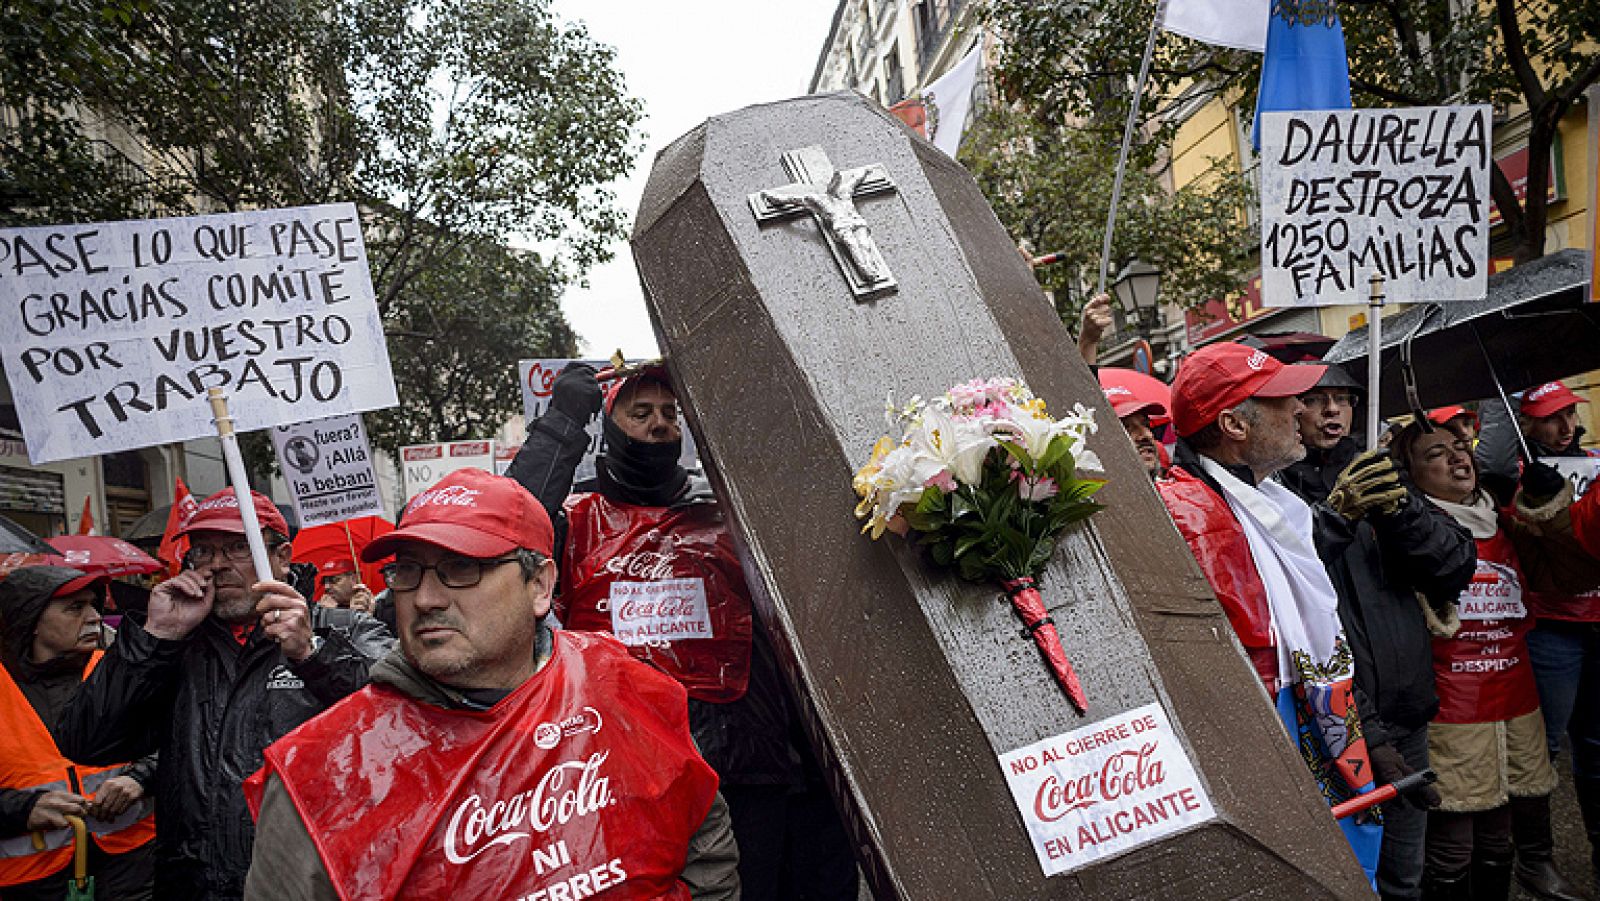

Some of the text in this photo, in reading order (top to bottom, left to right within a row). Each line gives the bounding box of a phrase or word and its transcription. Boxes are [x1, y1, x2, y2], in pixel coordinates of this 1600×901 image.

[1279, 109, 1486, 170] DAURELLA
[1285, 167, 1481, 223] DESTROZA
[132, 228, 172, 268] LO
[194, 224, 253, 262] QUE
[270, 218, 359, 262] PASE
[1265, 217, 1349, 269] 1250
[1290, 224, 1478, 299] FAMILIAS
[20, 265, 351, 337] GRACIAS COMITÉ
[20, 314, 353, 384] POR VUESTRO
[57, 356, 343, 440] TRABAJO
[314, 423, 359, 445] fuera?
[325, 446, 367, 470] ¡Allá
[294, 468, 374, 494] la beban!
[408, 464, 432, 482] NO
[637, 620, 707, 636] ALICANTE
[1464, 602, 1520, 614] ALICANTE
[1010, 714, 1157, 776] NO AL CIERRE DE
[1034, 739, 1167, 823] Coca-Cola
[1043, 787, 1201, 860] EN ALICANTE
[532, 840, 571, 875] NI
